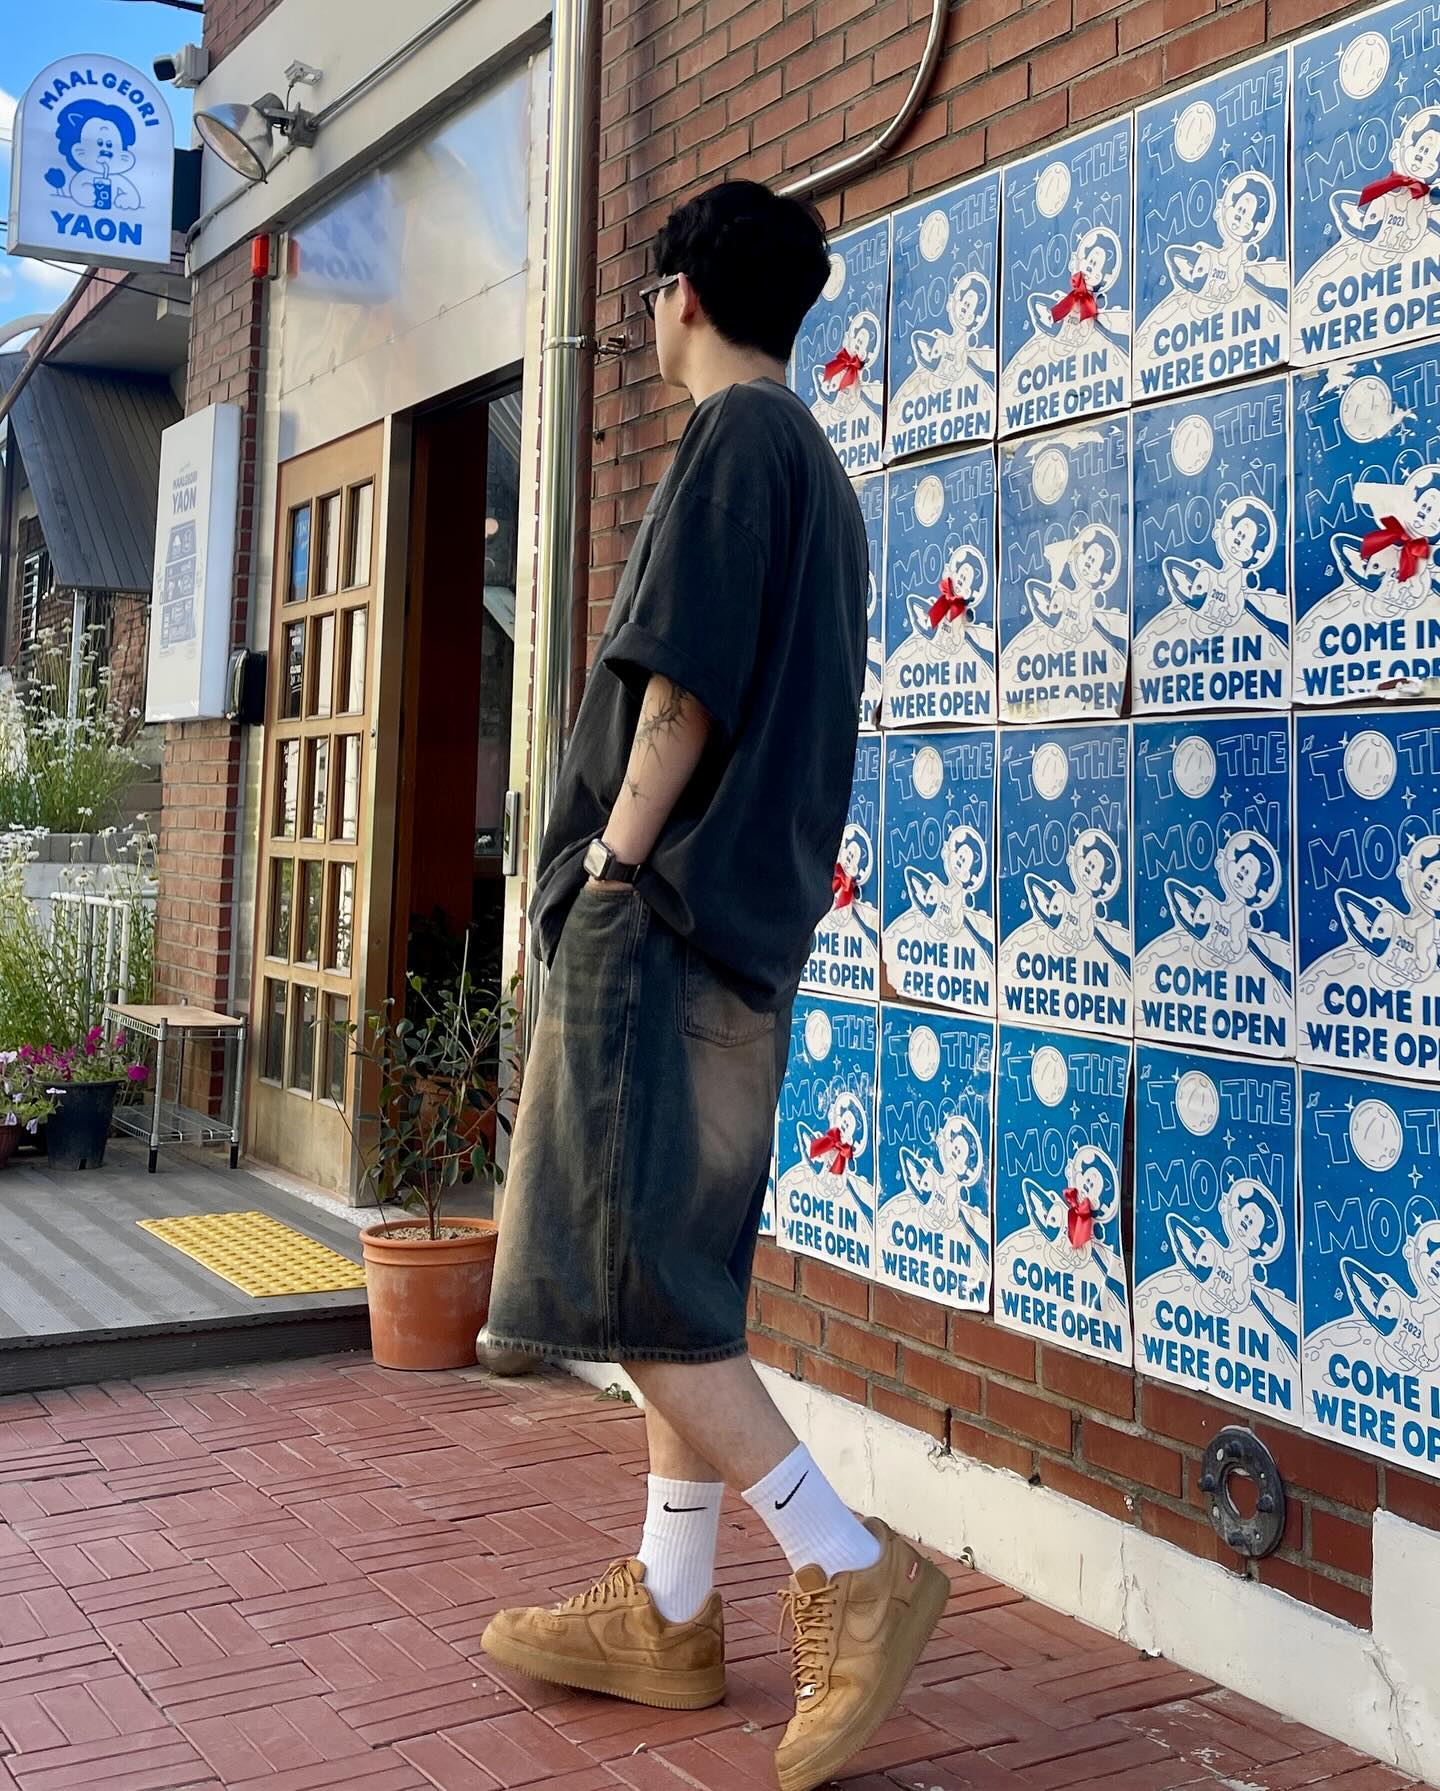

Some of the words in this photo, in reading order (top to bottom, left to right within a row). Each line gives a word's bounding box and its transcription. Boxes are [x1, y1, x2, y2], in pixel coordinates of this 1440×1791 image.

[1392, 2, 1440, 58] TH
[1218, 66, 1282, 126] THE
[1072, 130, 1127, 187] THE
[51, 210, 143, 246] YAON
[950, 184, 996, 234] THE
[1388, 215, 1404, 225] 2023
[847, 231, 886, 275] THE
[1317, 263, 1401, 312] COME
[1154, 312, 1223, 356] COME
[1232, 304, 1260, 335] IN
[1301, 308, 1377, 354] WERE
[1385, 294, 1440, 333] OPE
[1018, 356, 1075, 393] COME
[1083, 348, 1106, 376] IN
[1140, 352, 1202, 394] WERE
[1209, 334, 1279, 376] OPEN
[1394, 360, 1440, 410] TH
[902, 389, 951, 423] COME
[958, 383, 977, 408] IN
[1007, 392, 1058, 428] WERE
[1064, 376, 1123, 413] OPEN
[1215, 394, 1282, 447] THE
[825, 420, 847, 444] ME
[852, 416, 868, 438] IN
[892, 421, 936, 453] WERE
[940, 408, 990, 441] OPEN
[838, 440, 880, 469] OPEN
[1070, 429, 1125, 477] THE
[173, 486, 197, 514] YAON
[945, 460, 992, 503] THE
[859, 486, 882, 522] HE
[1153, 636, 1223, 668] COME
[1233, 635, 1261, 661] IN
[1319, 619, 1405, 657] COME
[900, 661, 949, 688] COME
[956, 661, 976, 683] IN
[1017, 651, 1075, 681] COME
[1083, 650, 1106, 674] IN
[1140, 673, 1203, 704] WERE
[1209, 669, 1282, 700] OPEN
[890, 693, 935, 718] WERE
[939, 691, 990, 715] OPEN
[853, 746, 880, 782] HE
[944, 743, 992, 779] THE
[1069, 738, 1126, 779] THE
[1218, 732, 1286, 776] THE
[1308, 809, 1440, 890] MOO
[844, 936, 861, 958] IN
[897, 939, 947, 967] COME
[954, 947, 974, 971] IN
[800, 959, 826, 984] ERE
[829, 963, 873, 990] OPEN
[903, 971, 934, 998] ERE
[937, 976, 988, 1006] OPEN
[1016, 952, 1076, 983] COME
[1084, 961, 1108, 988] IN
[1155, 964, 1226, 999] COME
[1236, 975, 1265, 1005] IN
[1005, 986, 1059, 1017] WERE
[1064, 992, 1125, 1026] OPEN
[1141, 1001, 1206, 1035] WERE
[1212, 1009, 1286, 1047] OPEN
[1323, 983, 1412, 1023] COME
[1423, 996, 1440, 1026] I
[833, 1017, 873, 1049] THE
[941, 1034, 989, 1070] THE
[1307, 1023, 1387, 1062] WERE
[1395, 1034, 1438, 1071] OP
[1069, 1056, 1126, 1096] THE
[1221, 1081, 1290, 1125] THE
[789, 1190, 833, 1224] COME
[839, 1207, 856, 1232] IN
[1314, 1194, 1437, 1255] MOO
[824, 1232, 869, 1268] OPEN
[892, 1221, 943, 1259] COME
[950, 1240, 970, 1268] IN
[882, 1251, 928, 1287] WERE
[1013, 1258, 1073, 1301] COME
[1081, 1281, 1105, 1313] IN
[1217, 1266, 1231, 1284] 2023
[1002, 1290, 1056, 1332] WERE
[1060, 1309, 1121, 1354] OPEN
[1156, 1300, 1229, 1349] COME
[1239, 1326, 1268, 1362] IN
[1403, 1318, 1421, 1339] 2023
[1143, 1334, 1209, 1382] WERE
[1215, 1358, 1290, 1410] OPEN
[1329, 1354, 1419, 1412] COME
[1431, 1386, 1437, 1418] I
[1313, 1391, 1394, 1448] WERE
[1402, 1421, 1440, 1465] OP
